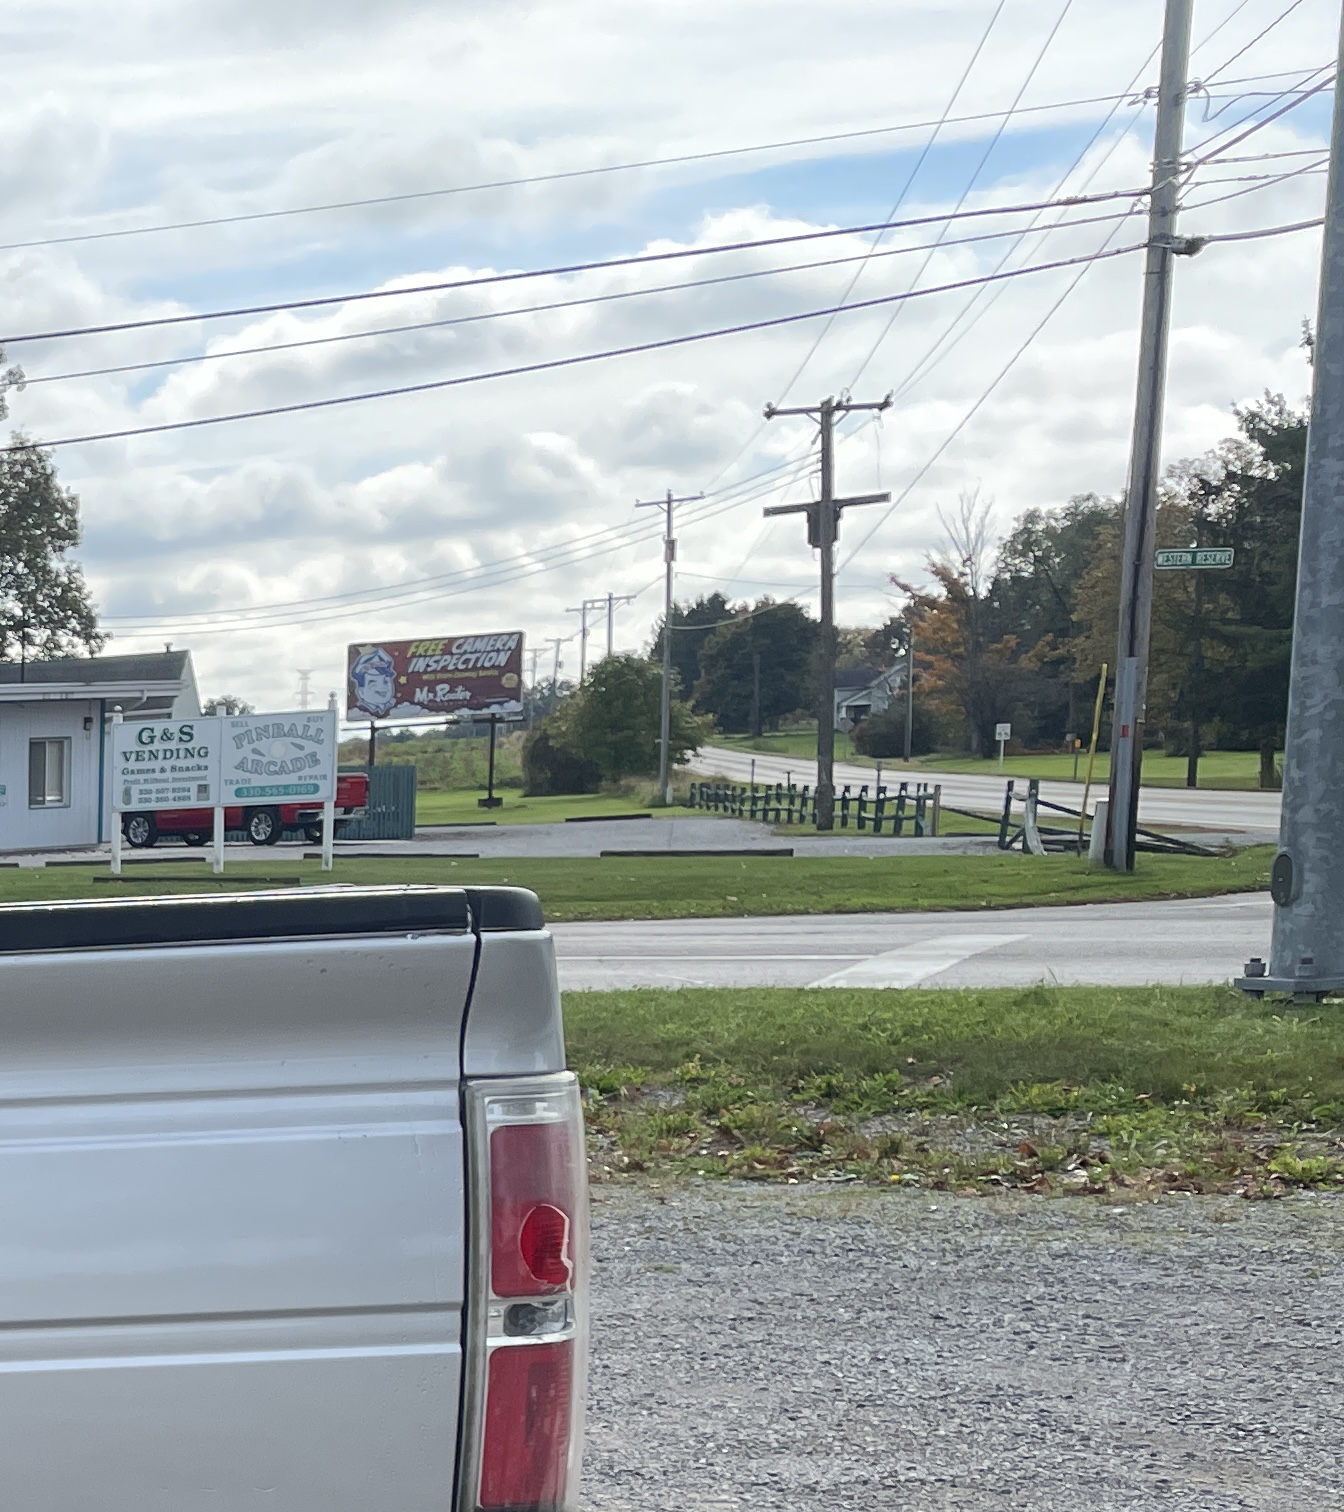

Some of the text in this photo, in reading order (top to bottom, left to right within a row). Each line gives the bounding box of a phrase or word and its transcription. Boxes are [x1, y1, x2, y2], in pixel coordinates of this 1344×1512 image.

[406, 633, 520, 658] FREE CAMERA
[407, 650, 512, 673] INSPECTION
[230, 720, 249, 728] SELL
[306, 715, 325, 723] BUY
[232, 722, 325, 750] PINBALL
[122, 746, 209, 763] VENDING
[121, 763, 209, 776] Games & Snacks
[234, 751, 321, 776] ARCADE
[224, 777, 252, 786] TRADE
[297, 773, 328, 782] REPAIR
[240, 784, 314, 797] 330-565-0169
